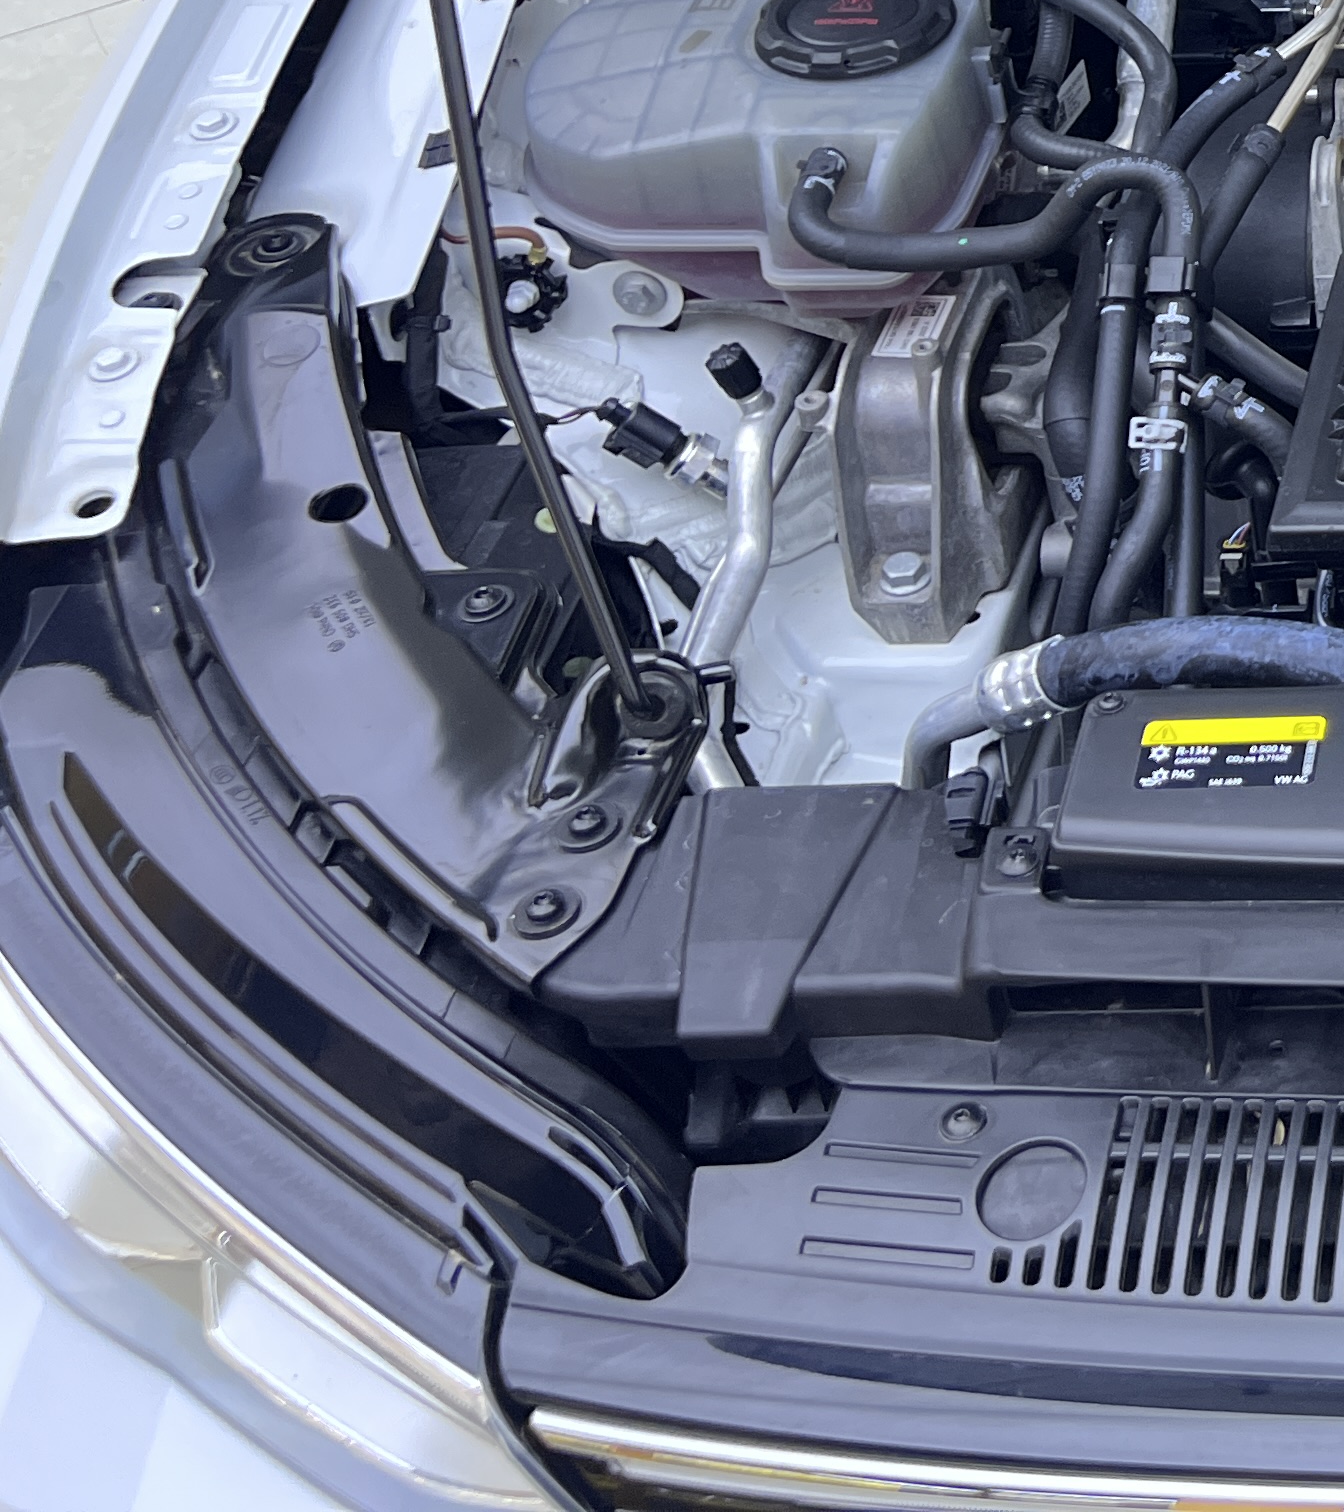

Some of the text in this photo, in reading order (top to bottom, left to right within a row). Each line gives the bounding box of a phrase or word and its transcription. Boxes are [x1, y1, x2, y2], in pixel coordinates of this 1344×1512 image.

[1171, 769, 1195, 780] PAG
[1274, 774, 1309, 785] VW AG
